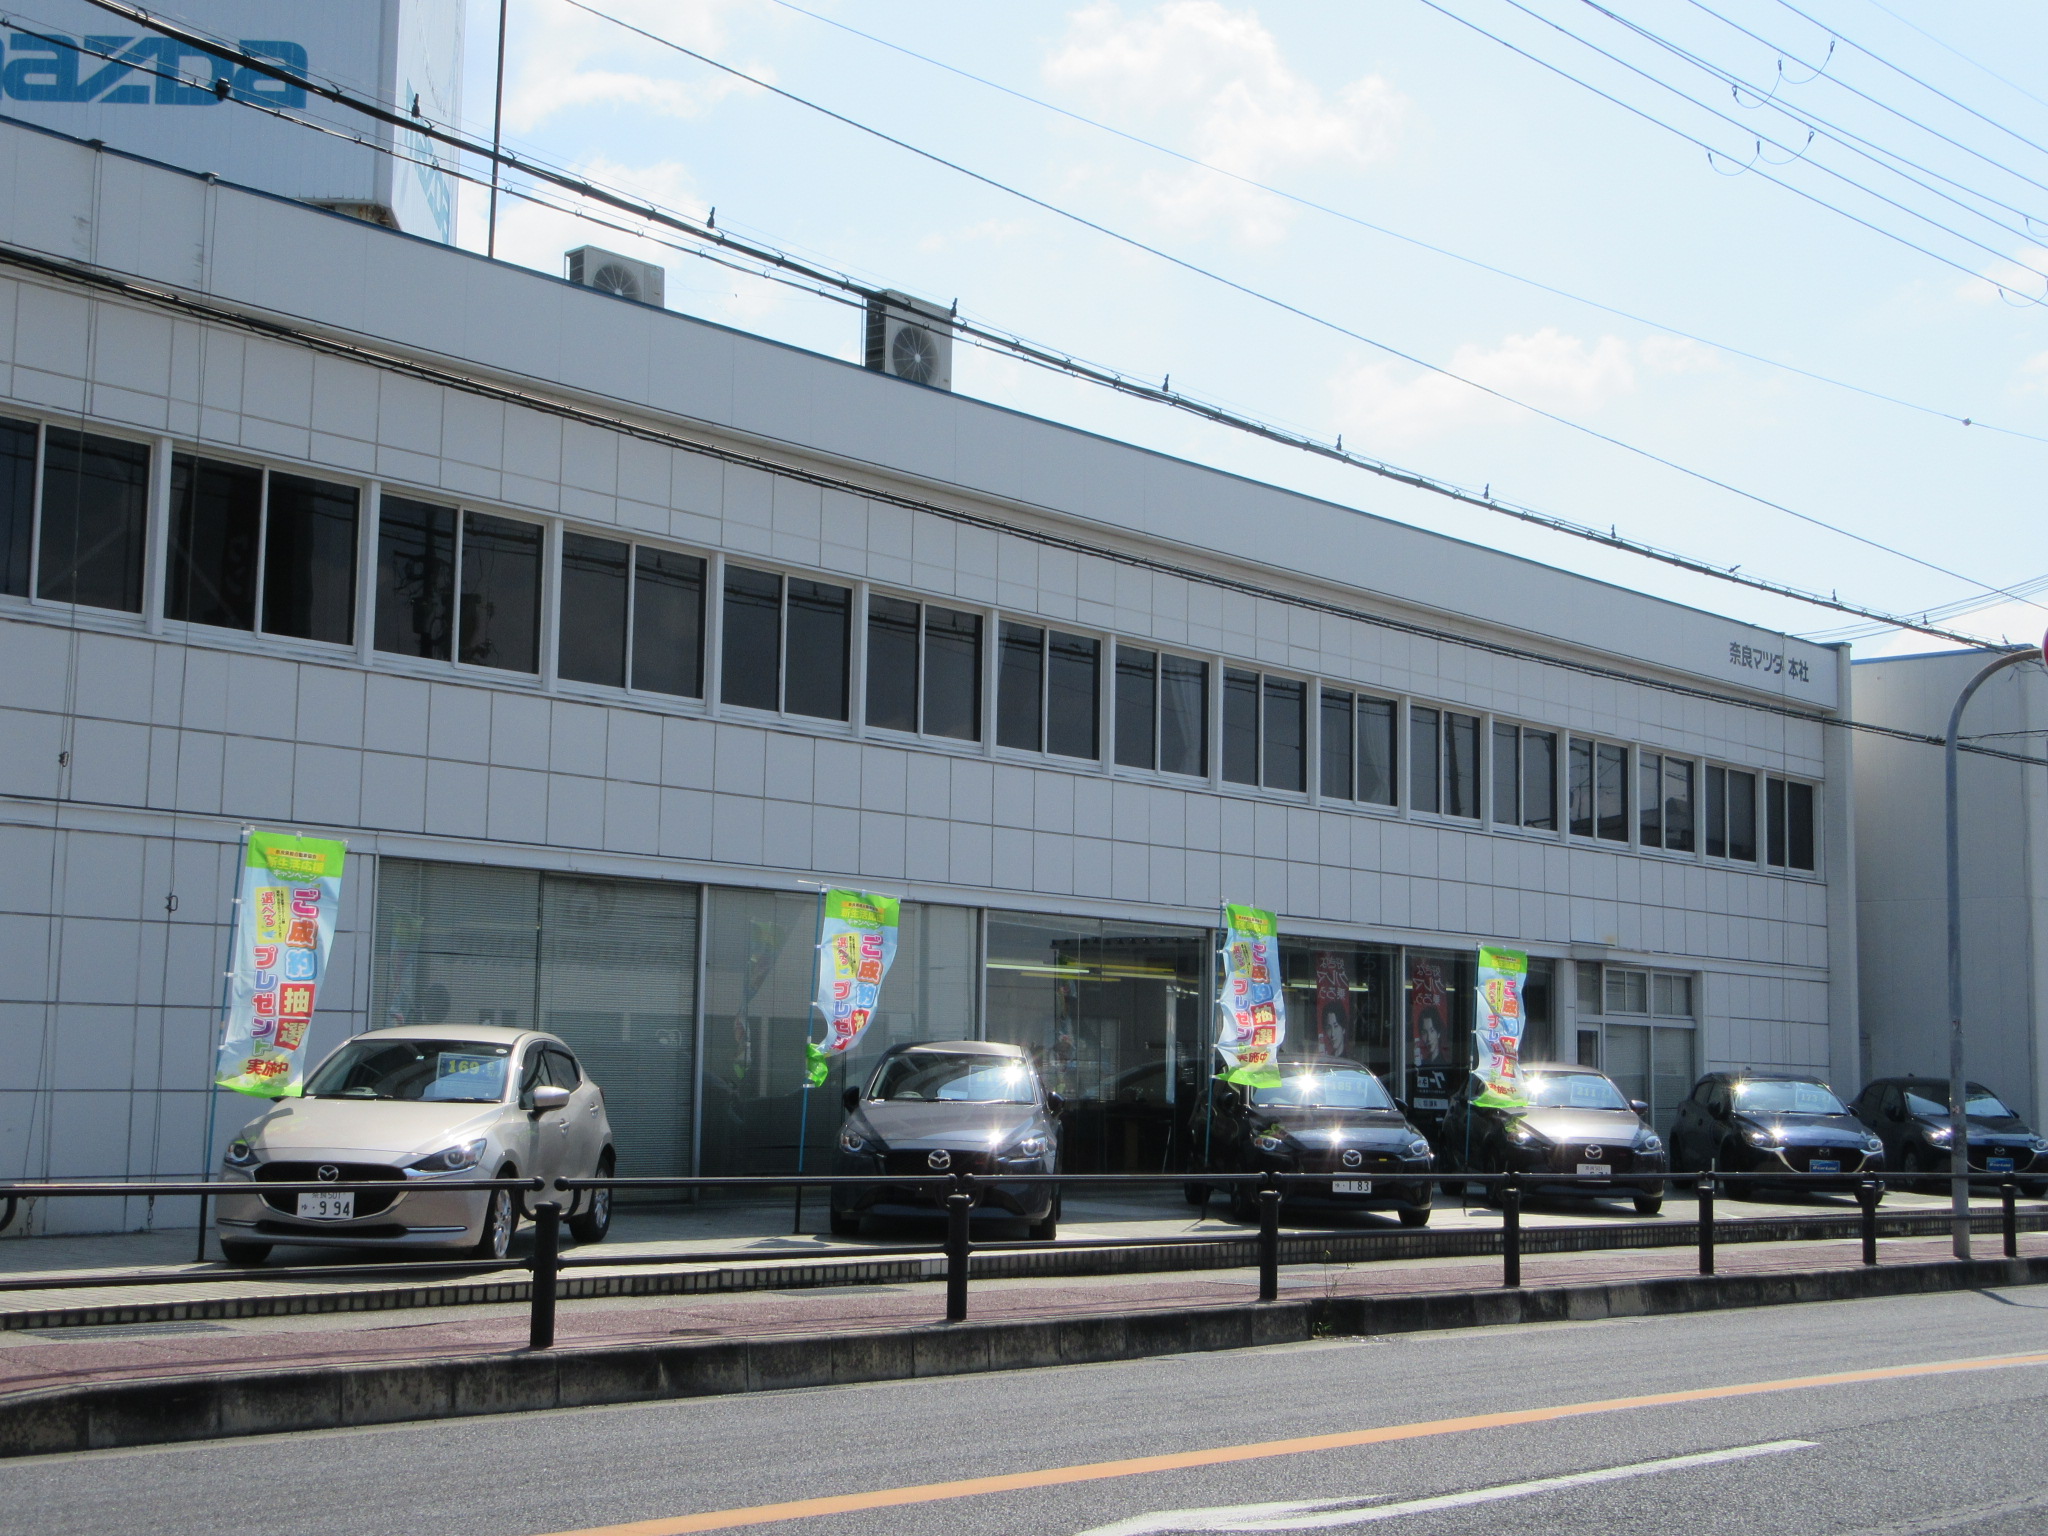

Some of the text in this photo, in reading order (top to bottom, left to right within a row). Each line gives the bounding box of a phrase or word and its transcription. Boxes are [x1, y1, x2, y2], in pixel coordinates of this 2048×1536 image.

[273, 869, 317, 881] キャンペーン
[251, 945, 278, 1057] プレゼント
[245, 1058, 289, 1077] 実施中
